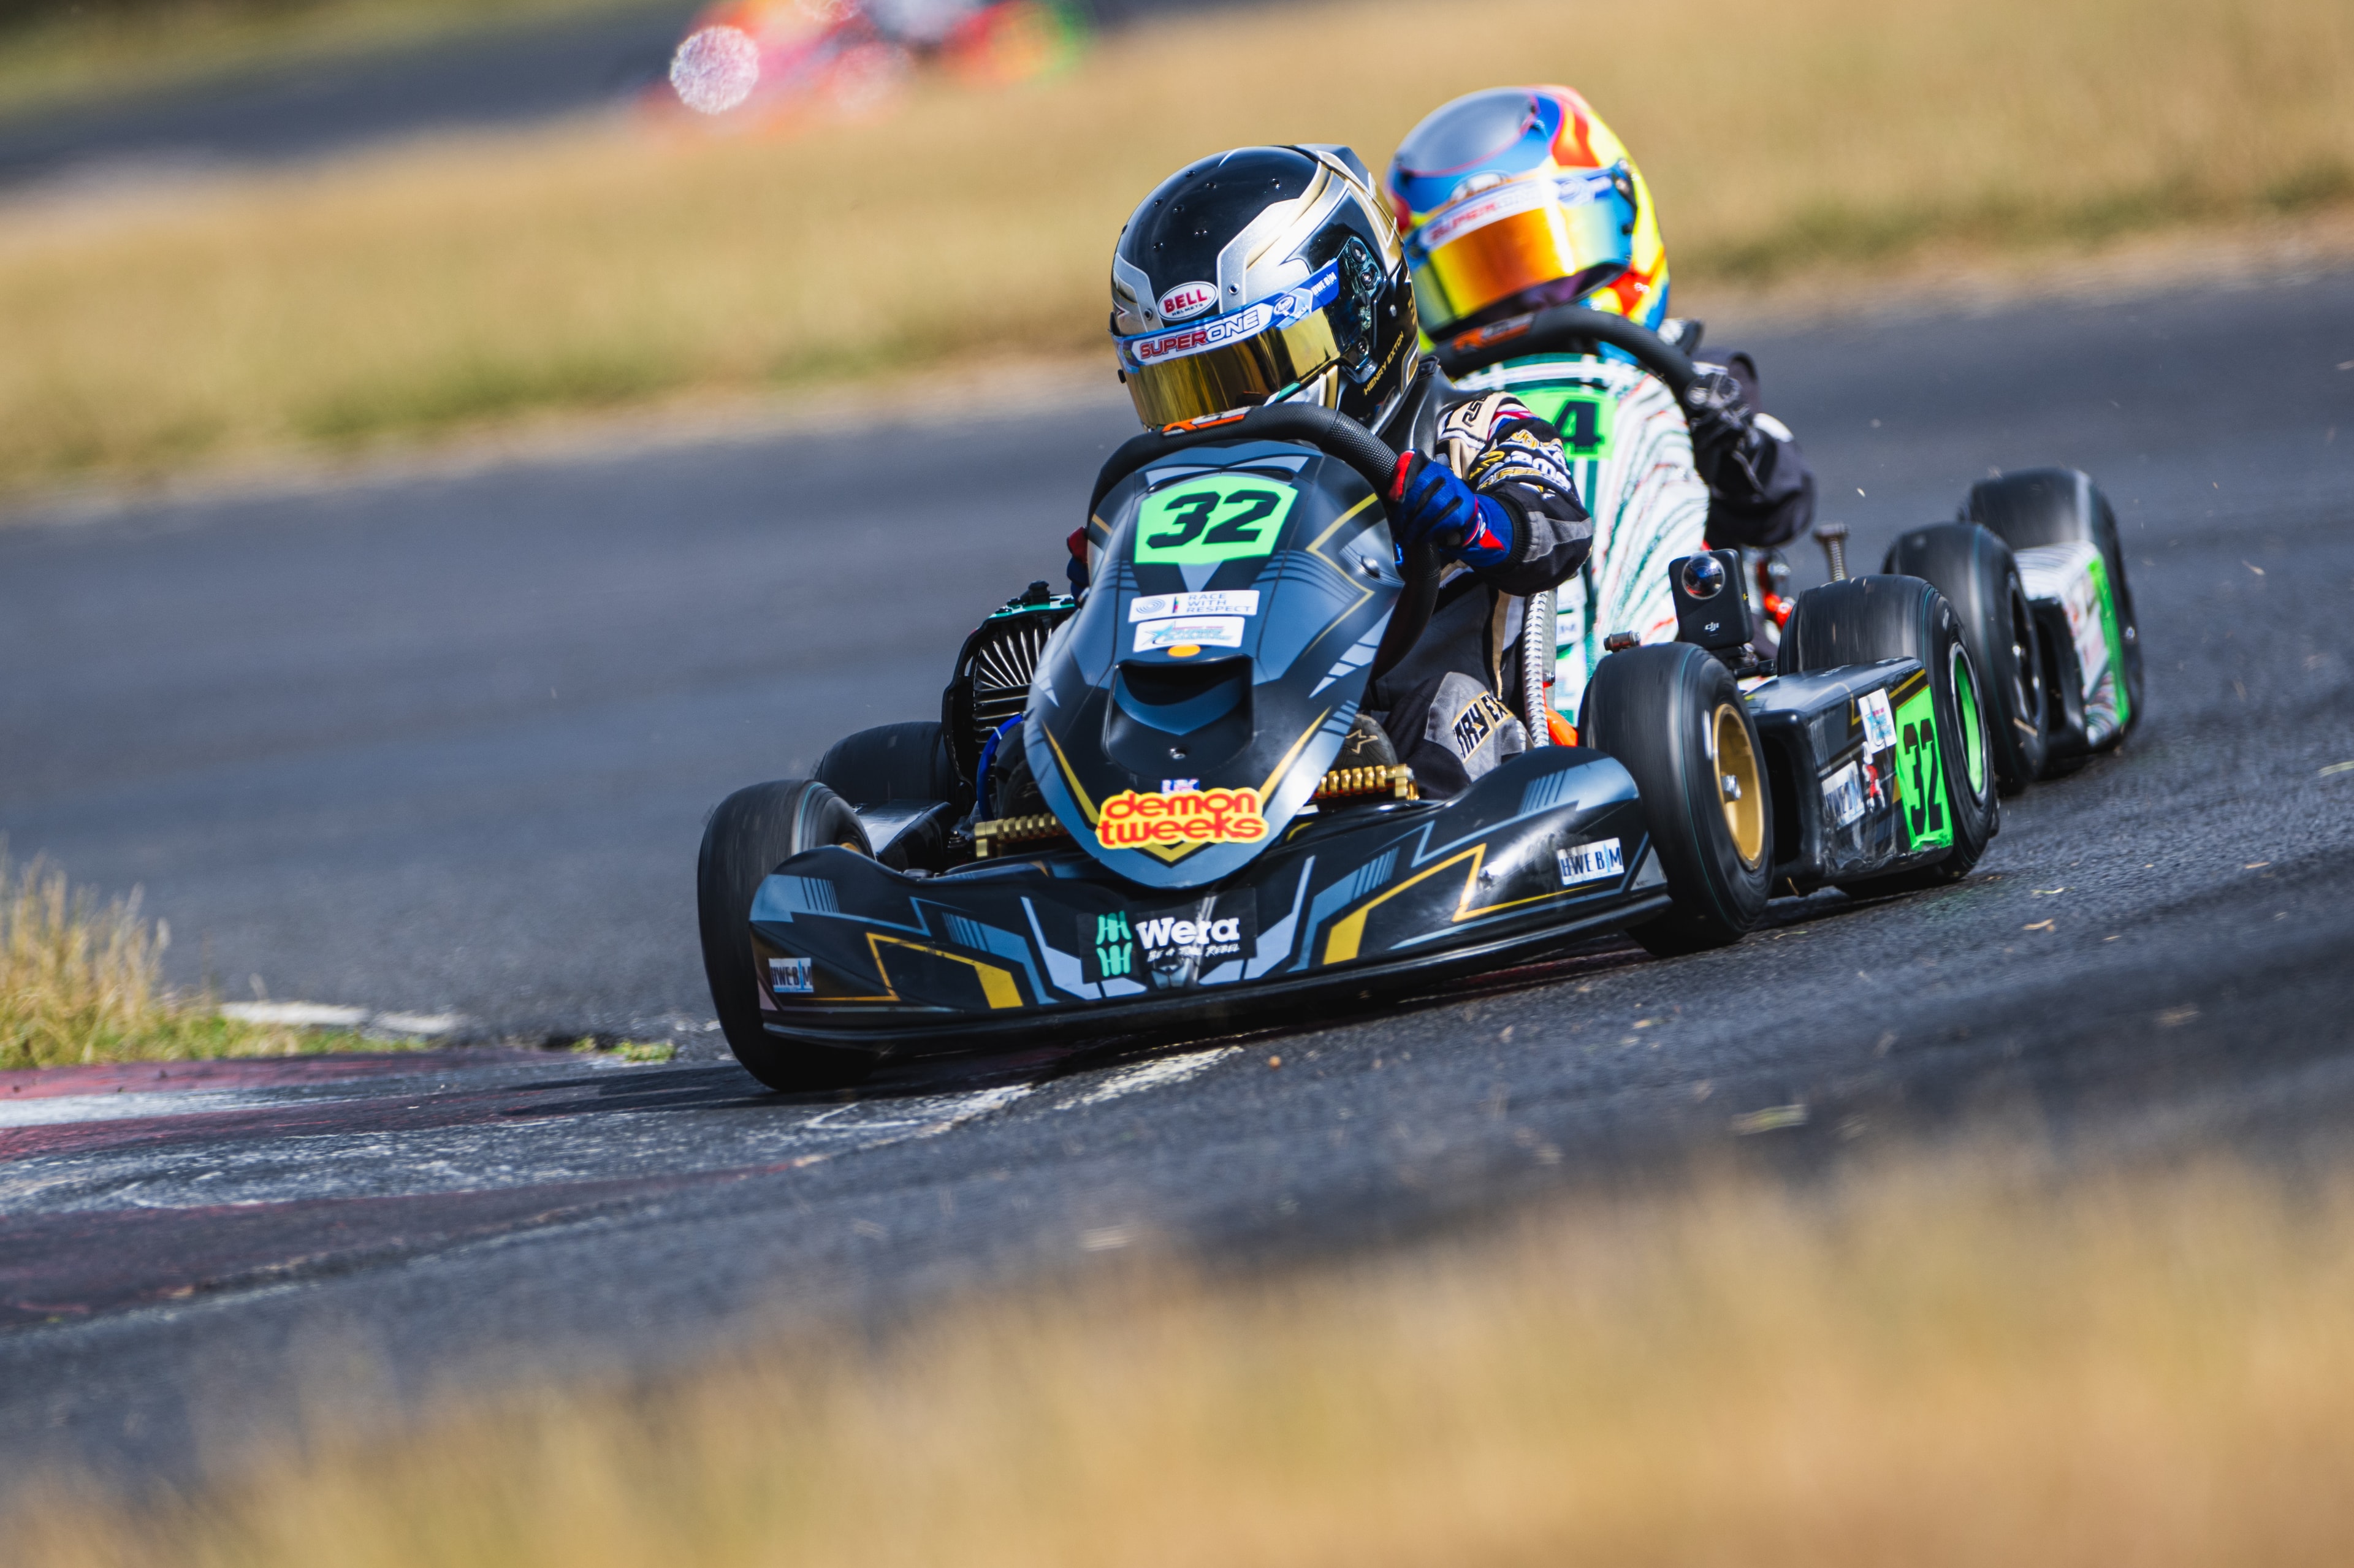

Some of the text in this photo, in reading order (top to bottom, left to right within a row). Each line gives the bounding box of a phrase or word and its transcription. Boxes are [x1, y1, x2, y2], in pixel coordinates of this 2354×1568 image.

[1164, 289, 1208, 314] BELL
[1171, 303, 1203, 316] HELMETS
[1363, 330, 1404, 396] HENRY EXTON
[1553, 400, 1604, 452] 4
[1145, 489, 1282, 549] 32
[1903, 717, 1945, 837] 32
[1105, 792, 1256, 820] demon
[1097, 816, 1264, 845] tweeks
[1560, 853, 1594, 877] HWE
[1135, 917, 1240, 950] Wera
[1148, 949, 1164, 962] BE
[1205, 943, 1241, 957] REBEL
[771, 966, 793, 986] HWE
